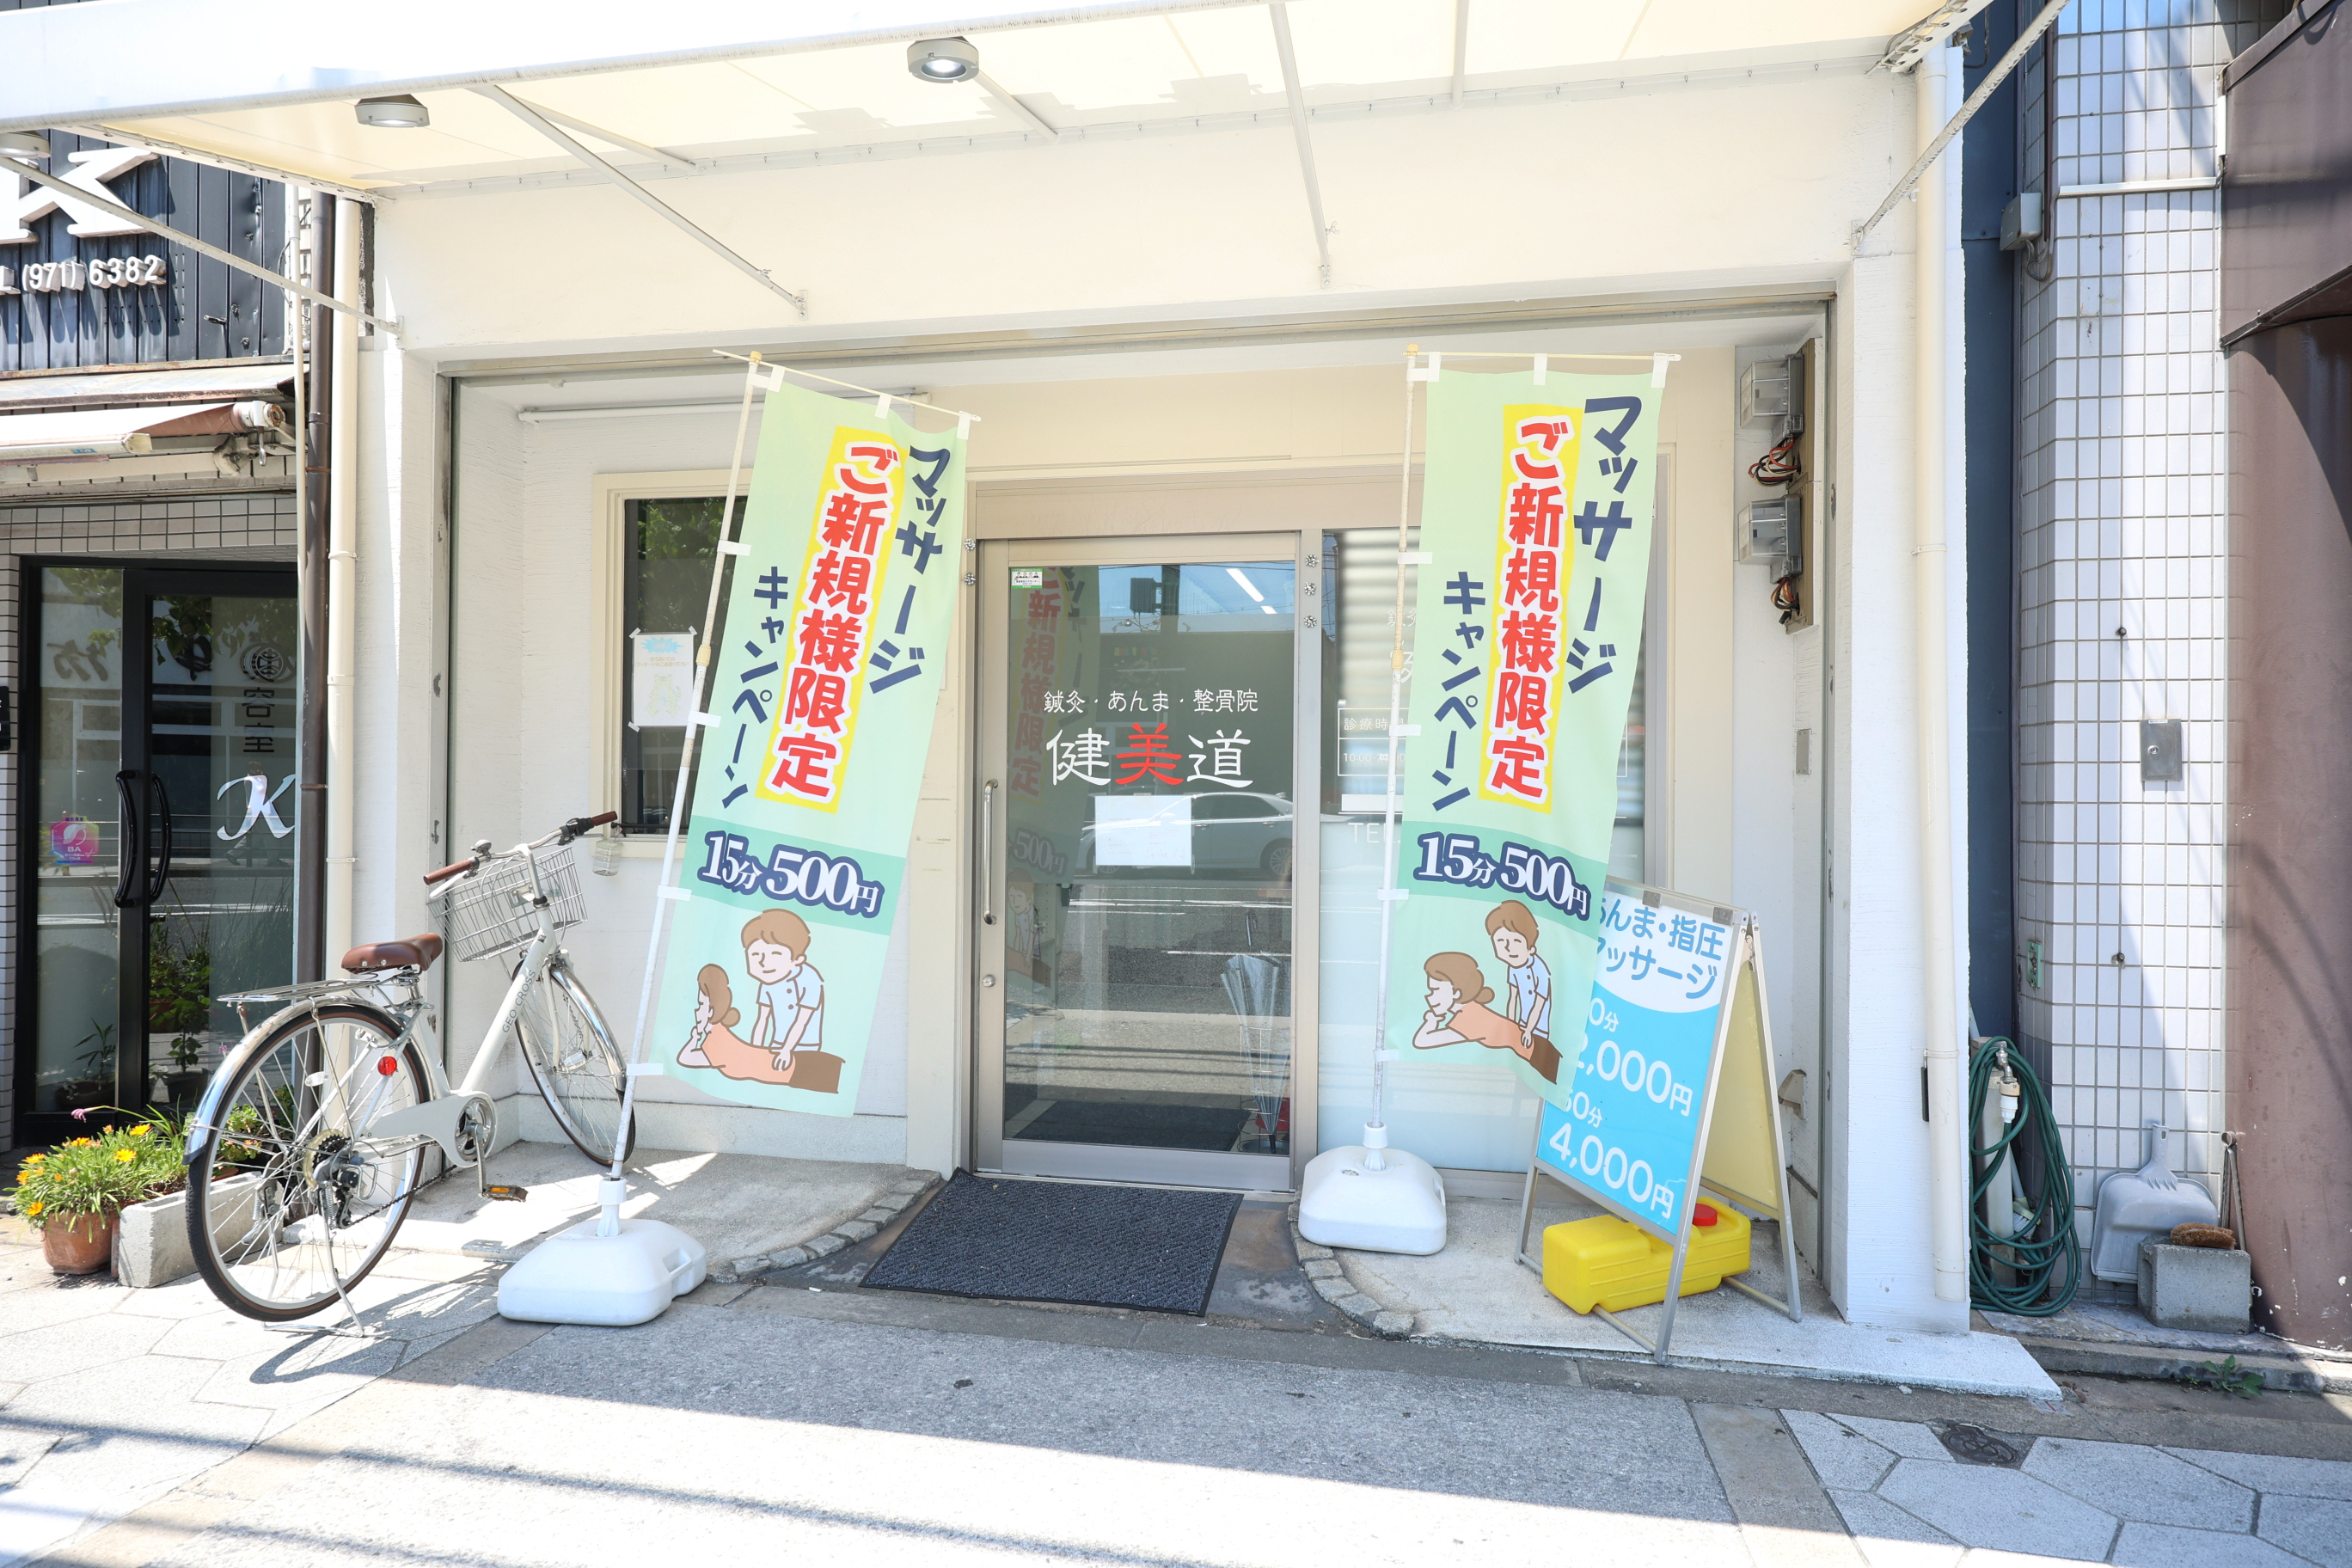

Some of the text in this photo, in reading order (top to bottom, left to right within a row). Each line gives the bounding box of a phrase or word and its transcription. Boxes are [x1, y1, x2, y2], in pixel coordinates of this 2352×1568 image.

[22, 260, 77, 292] (971)
[89, 254, 161, 288] 6382
[771, 444, 902, 799] ご新規様限定
[869, 444, 952, 695] マッサージ
[1491, 420, 1570, 799] ご新規様限定
[1566, 396, 1642, 695] マッサージ
[721, 566, 789, 809] キャンペーン
[1046, 722, 1253, 788] 健美道
[1344, 717, 1404, 731] 診療時
[1432, 571, 1486, 812] キャンペーン
[502, 970, 536, 1032] GEO CROSS
[1589, 997, 1619, 1032] 0分
[1549, 1122, 1675, 1220] 4,000円
